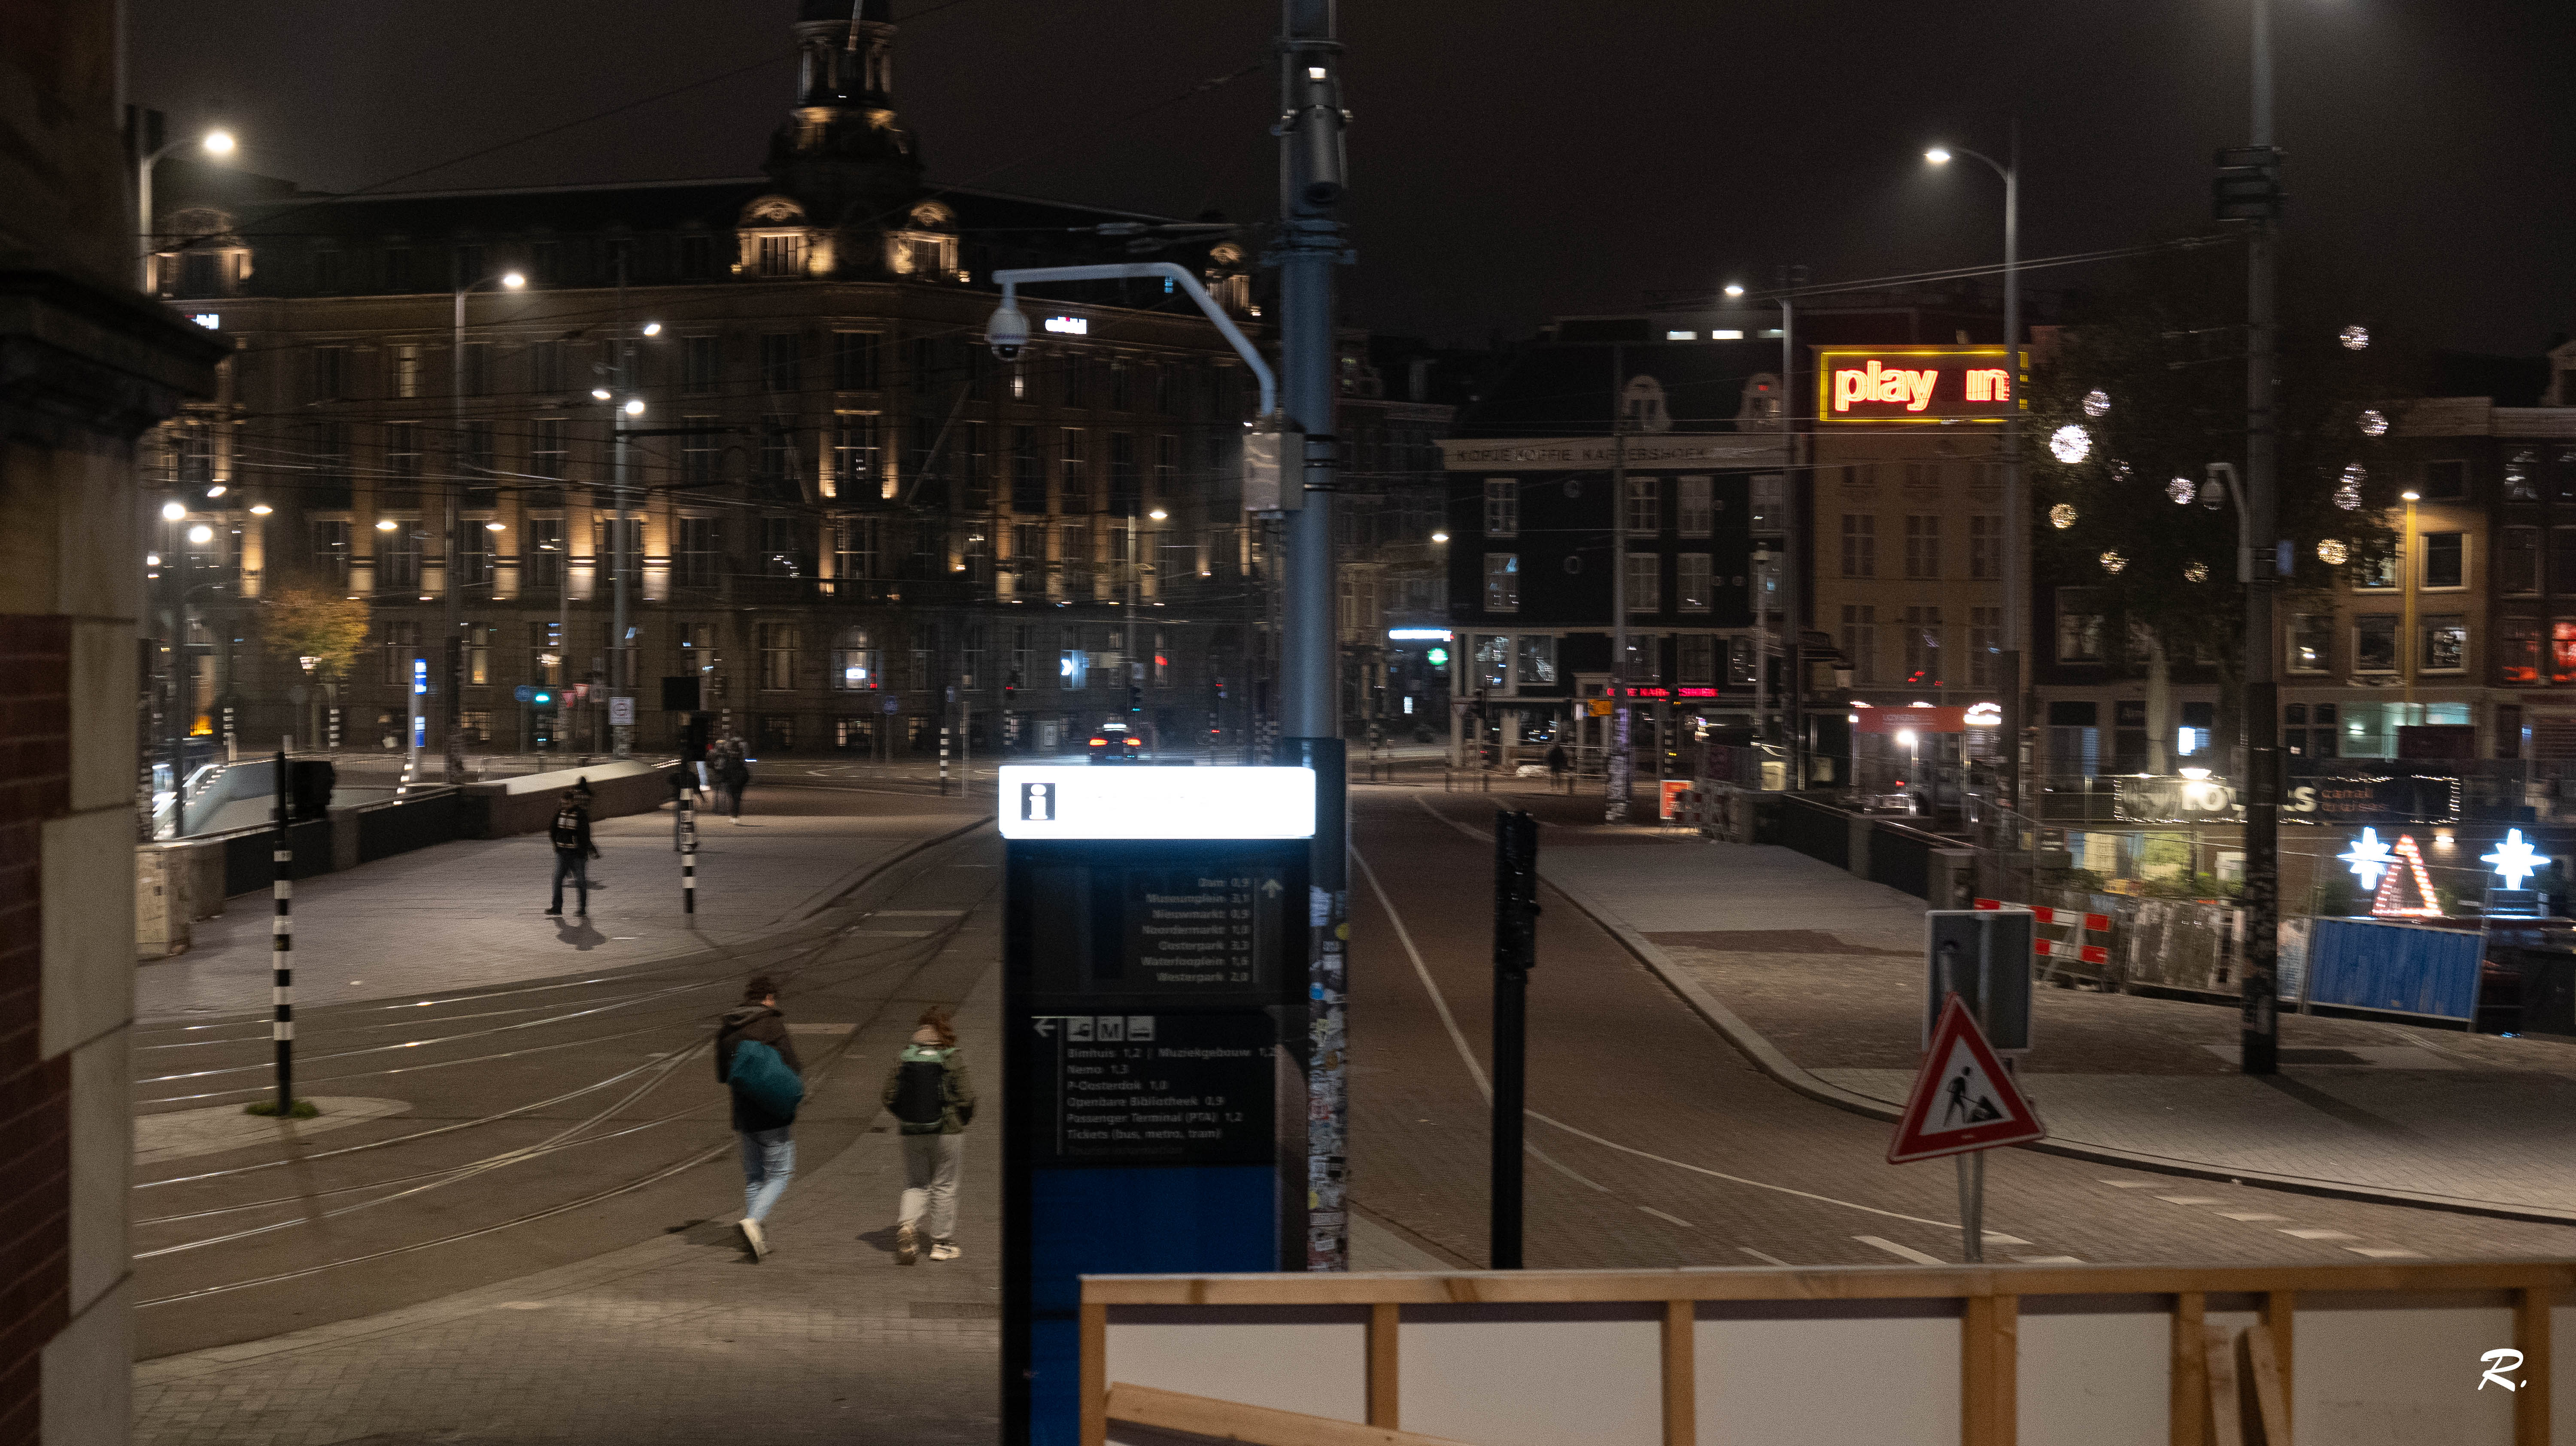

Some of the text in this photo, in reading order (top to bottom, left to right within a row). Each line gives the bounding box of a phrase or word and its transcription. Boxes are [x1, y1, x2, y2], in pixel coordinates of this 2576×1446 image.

[1835, 360, 1939, 411] play
[1198, 878, 1227, 887] Dam
[1145, 893, 1227, 905] Museumplein
[1152, 908, 1226, 919] Nieuwmarkt
[1142, 924, 1226, 934] Noordermarkt
[1158, 940, 1224, 951] Oosterpark
[1140, 956, 1226, 967] Waterlooplein
[1156, 972, 1224, 983] Westerpark
[1067, 1048, 1116, 1058] Bimhuis
[1158, 1048, 1252, 1060] Muziekgebouw
[1067, 1064, 1130, 1075] Nemo 1,3
[1067, 1080, 1142, 1091] P-Oosterdok
[1067, 1097, 1127, 1108] Openbare
[1130, 1096, 1199, 1106] Bibliotheek
[1067, 1112, 1243, 1124] Passenger Terminal (PTA) 1,2
[1067, 1129, 1223, 1140] Tickets (bus, metro, tram)
